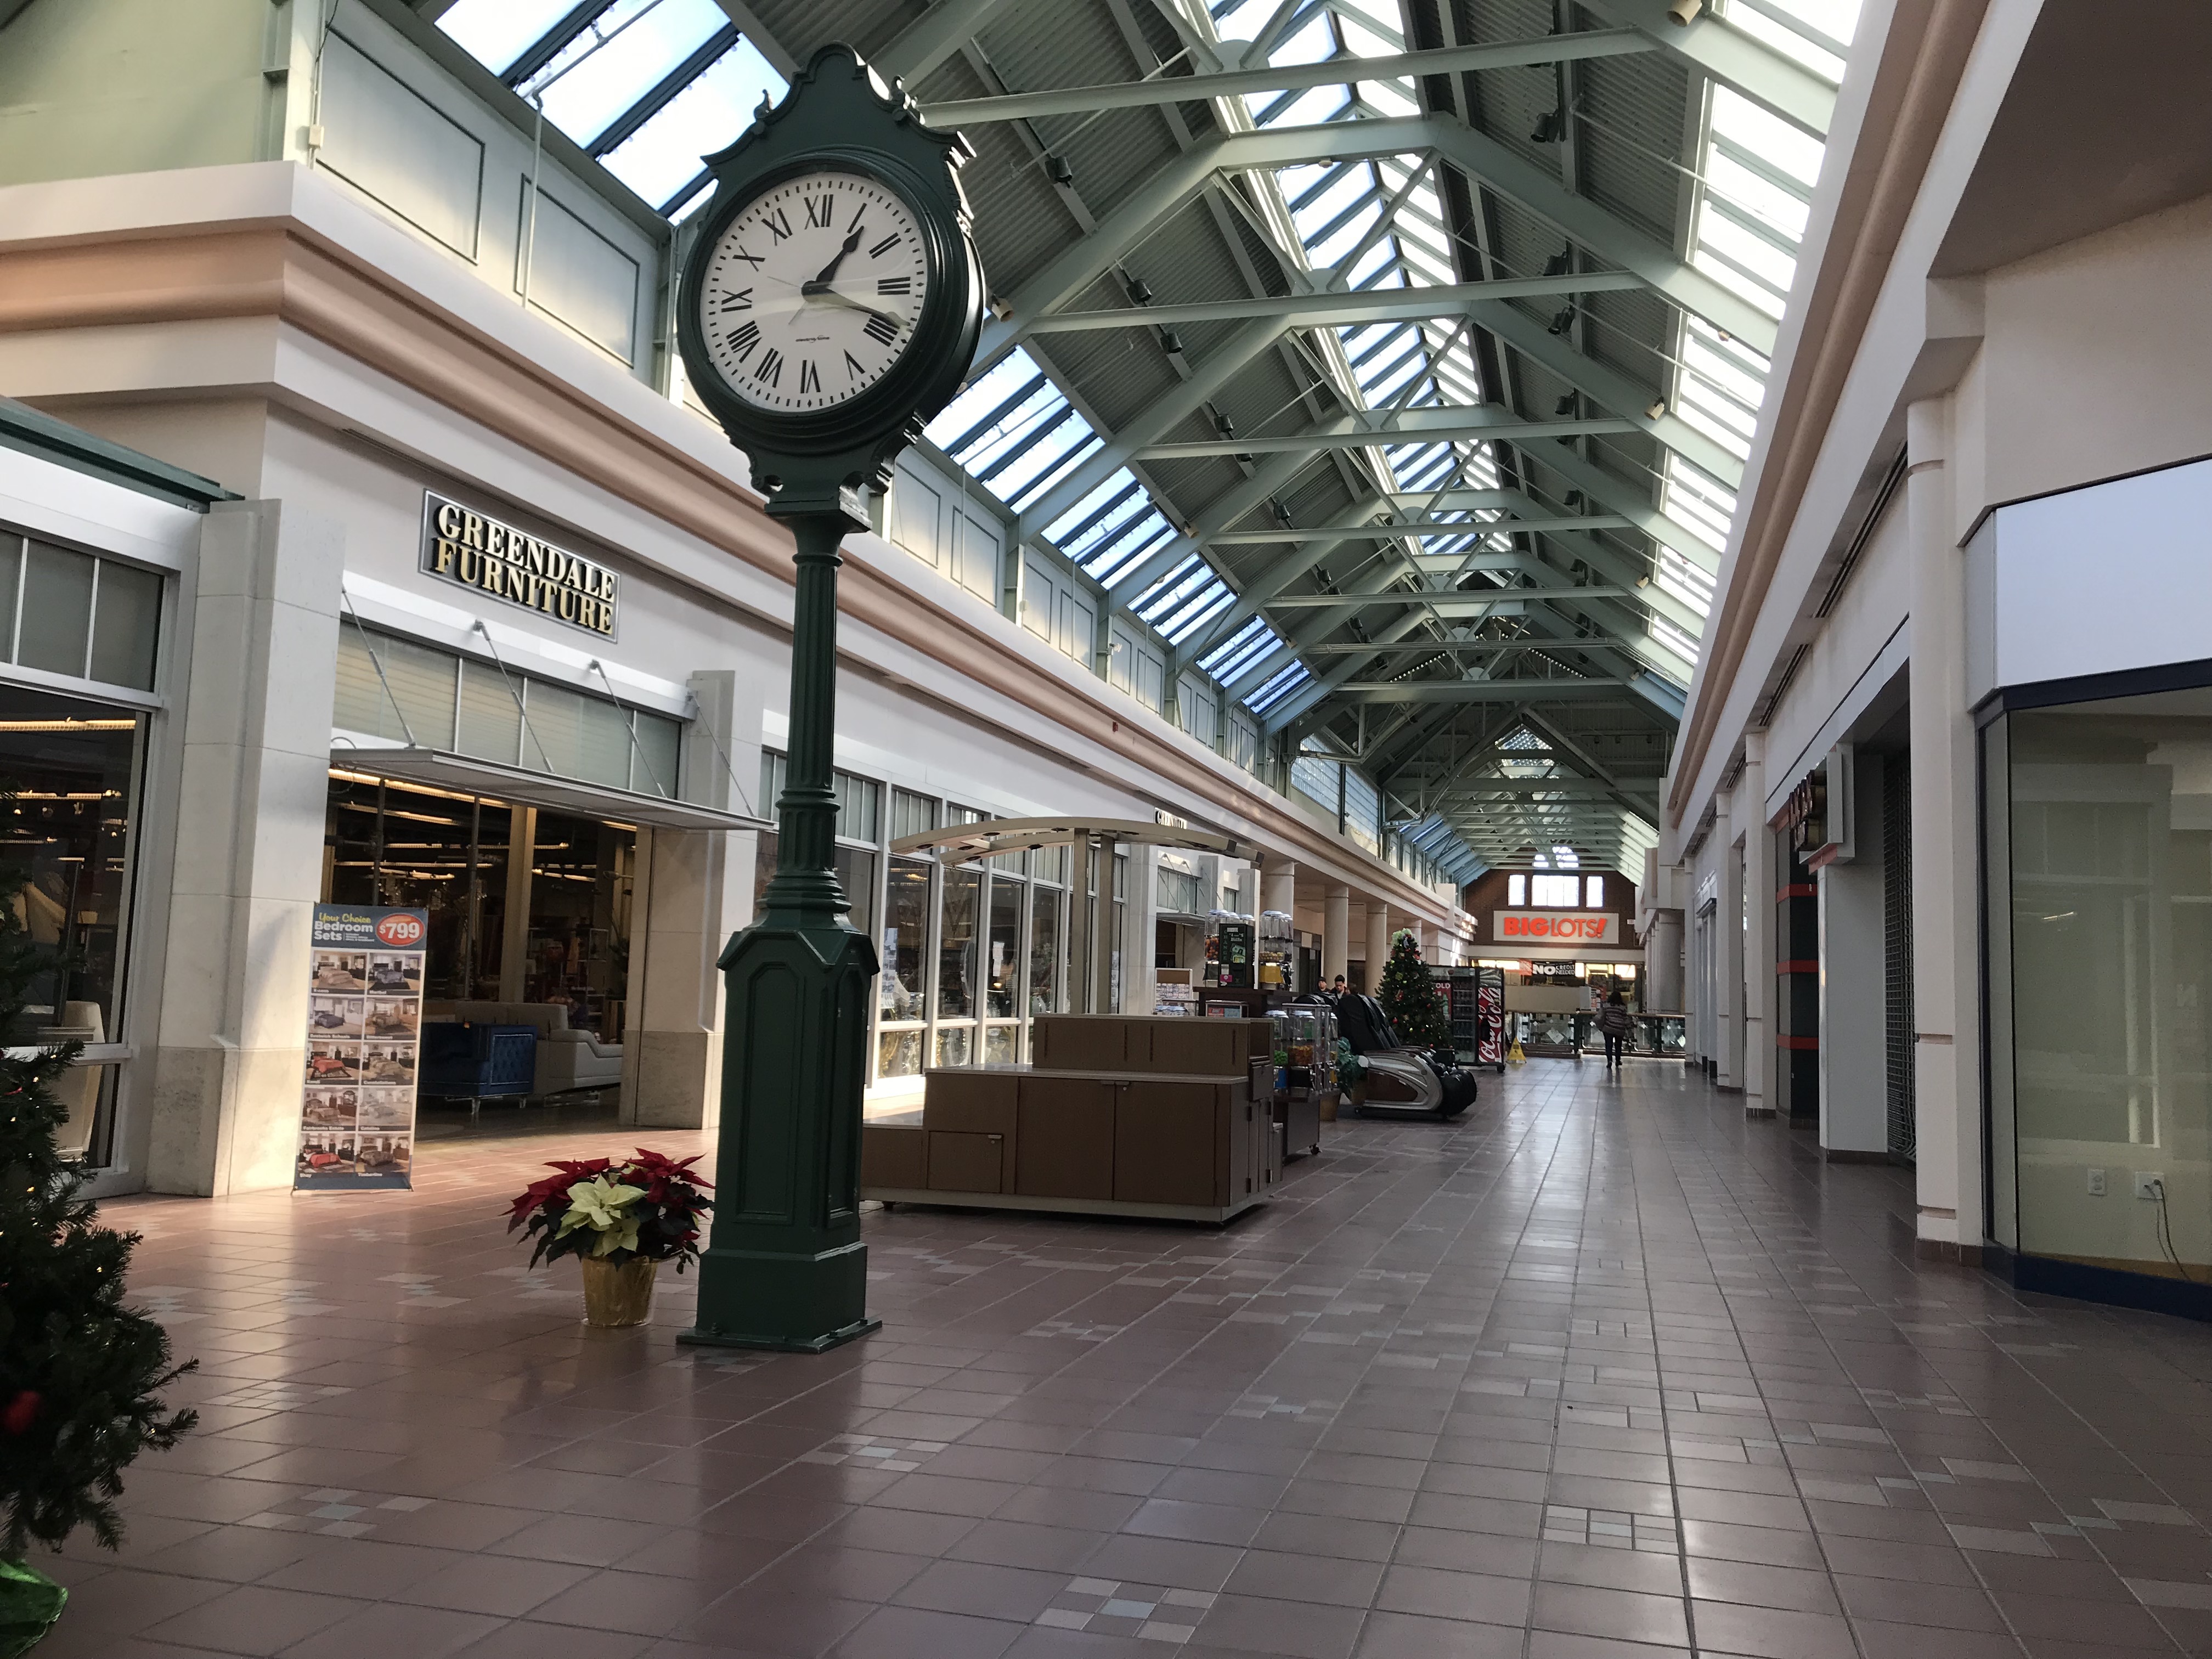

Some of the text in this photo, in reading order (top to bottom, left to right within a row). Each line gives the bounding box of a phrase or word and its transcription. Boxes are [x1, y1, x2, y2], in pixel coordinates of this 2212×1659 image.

[438, 504, 615, 603] GREENDALE
[435, 537, 614, 635] FURNITURE
[318, 912, 372, 924] Your Choice
[314, 921, 374, 933] Bedroom
[379, 922, 420, 939] $799
[1503, 917, 1608, 939] BIG LOTS!
[314, 930, 342, 941] Sets
[1532, 963, 1556, 975] NO
